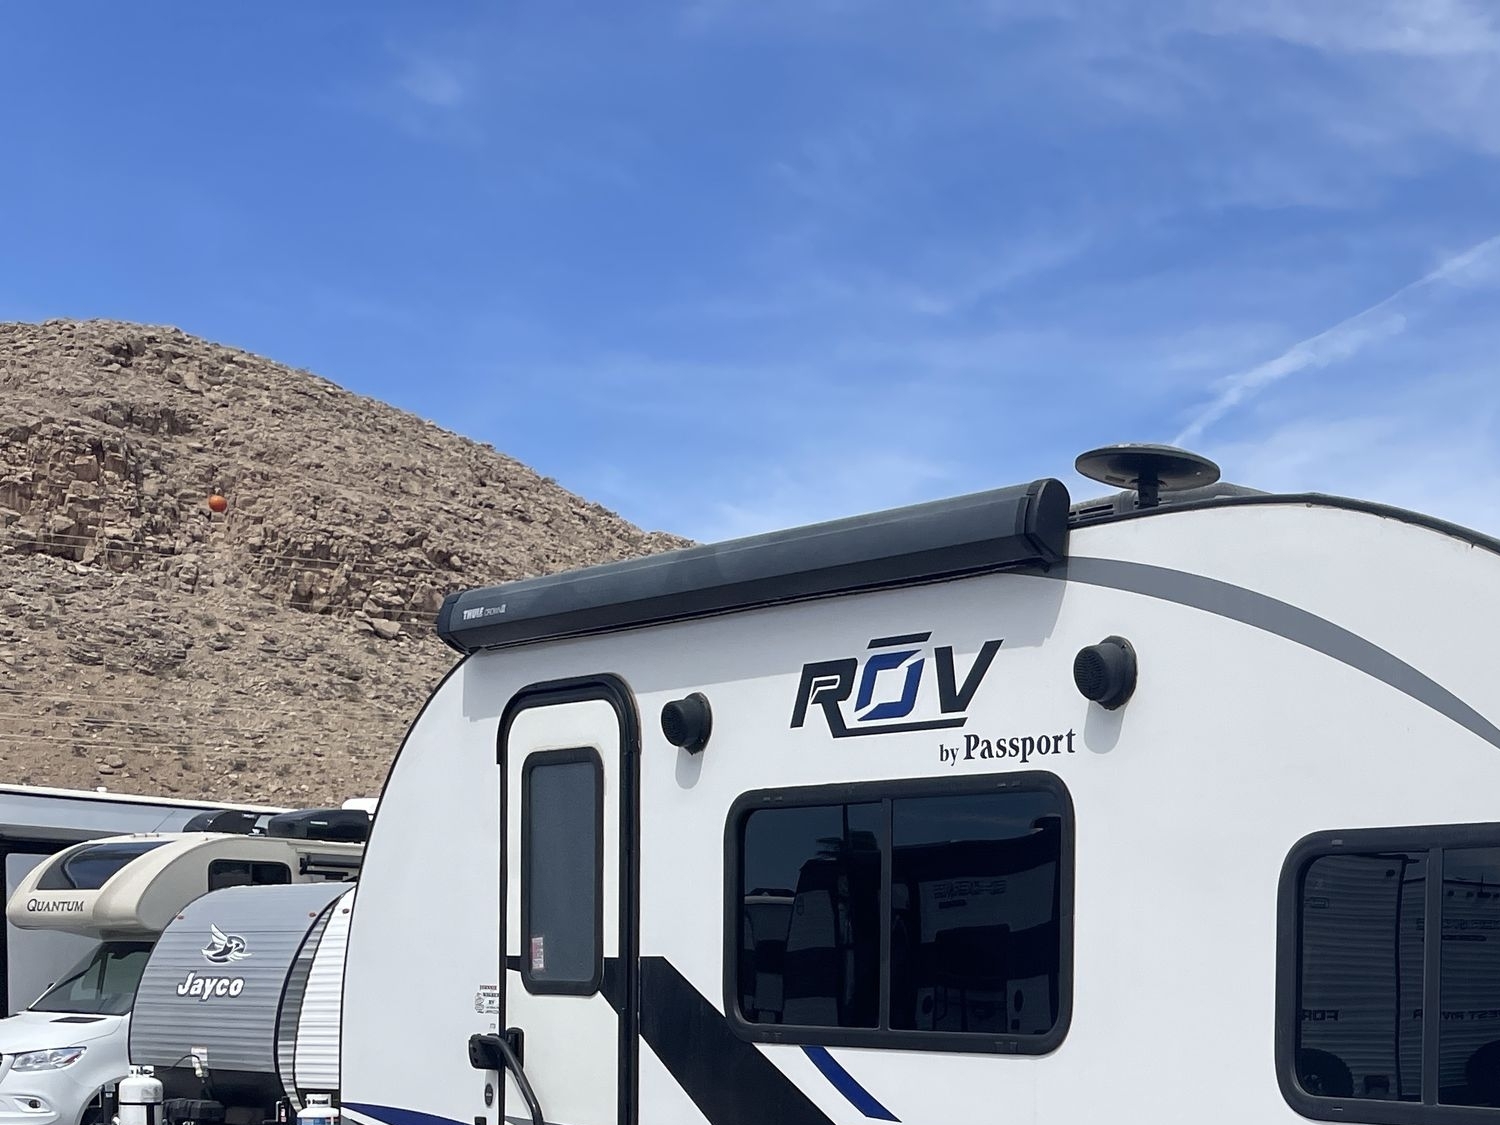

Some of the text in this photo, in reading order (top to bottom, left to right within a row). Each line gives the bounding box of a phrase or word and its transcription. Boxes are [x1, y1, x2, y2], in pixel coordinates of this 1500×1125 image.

[463, 607, 484, 620] THULE
[939, 729, 1077, 767] by Passport
[26, 898, 84, 913] QUANTUM
[176, 970, 246, 1002] Jayco
